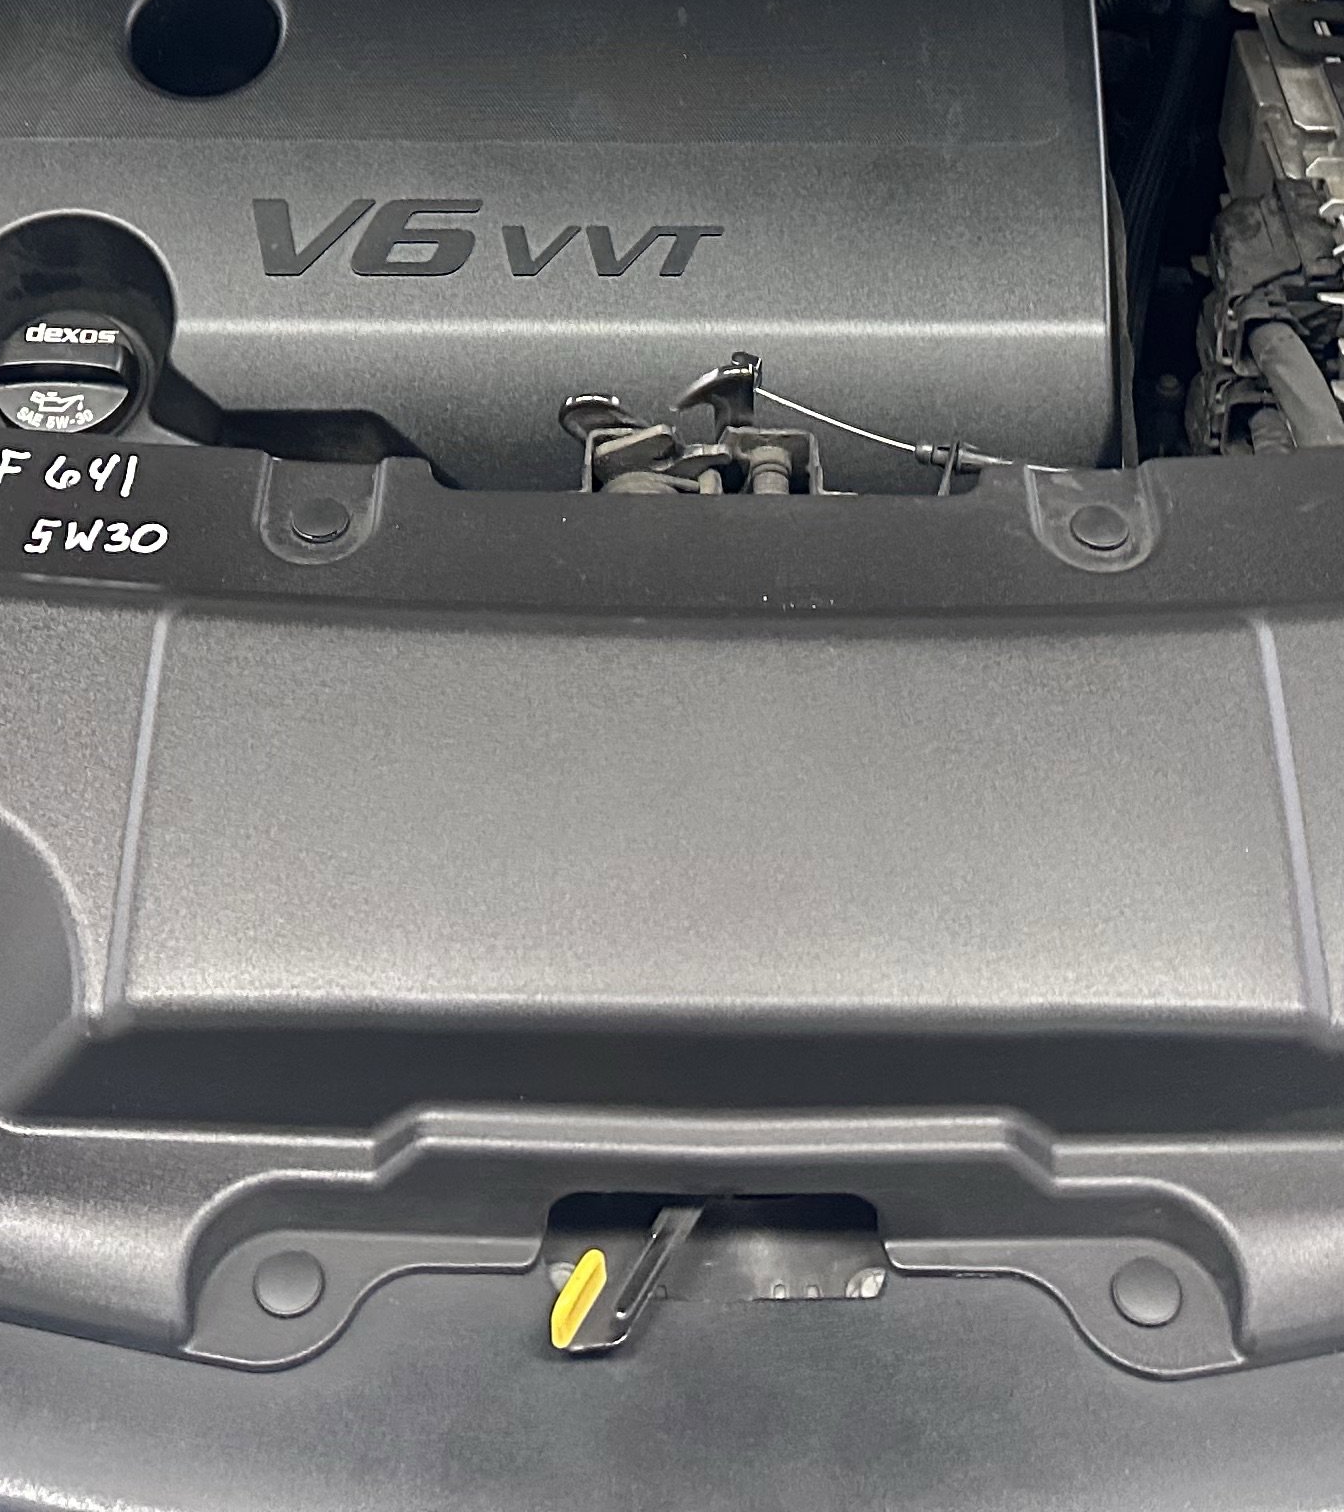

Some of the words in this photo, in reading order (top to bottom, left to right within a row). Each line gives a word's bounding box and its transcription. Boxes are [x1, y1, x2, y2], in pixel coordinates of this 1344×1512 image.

[253, 198, 483, 277] V6
[501, 224, 725, 277] VVT
[25, 322, 120, 344] dexos
[16, 406, 44, 428] SAE
[46, 409, 94, 430] 5W-30
